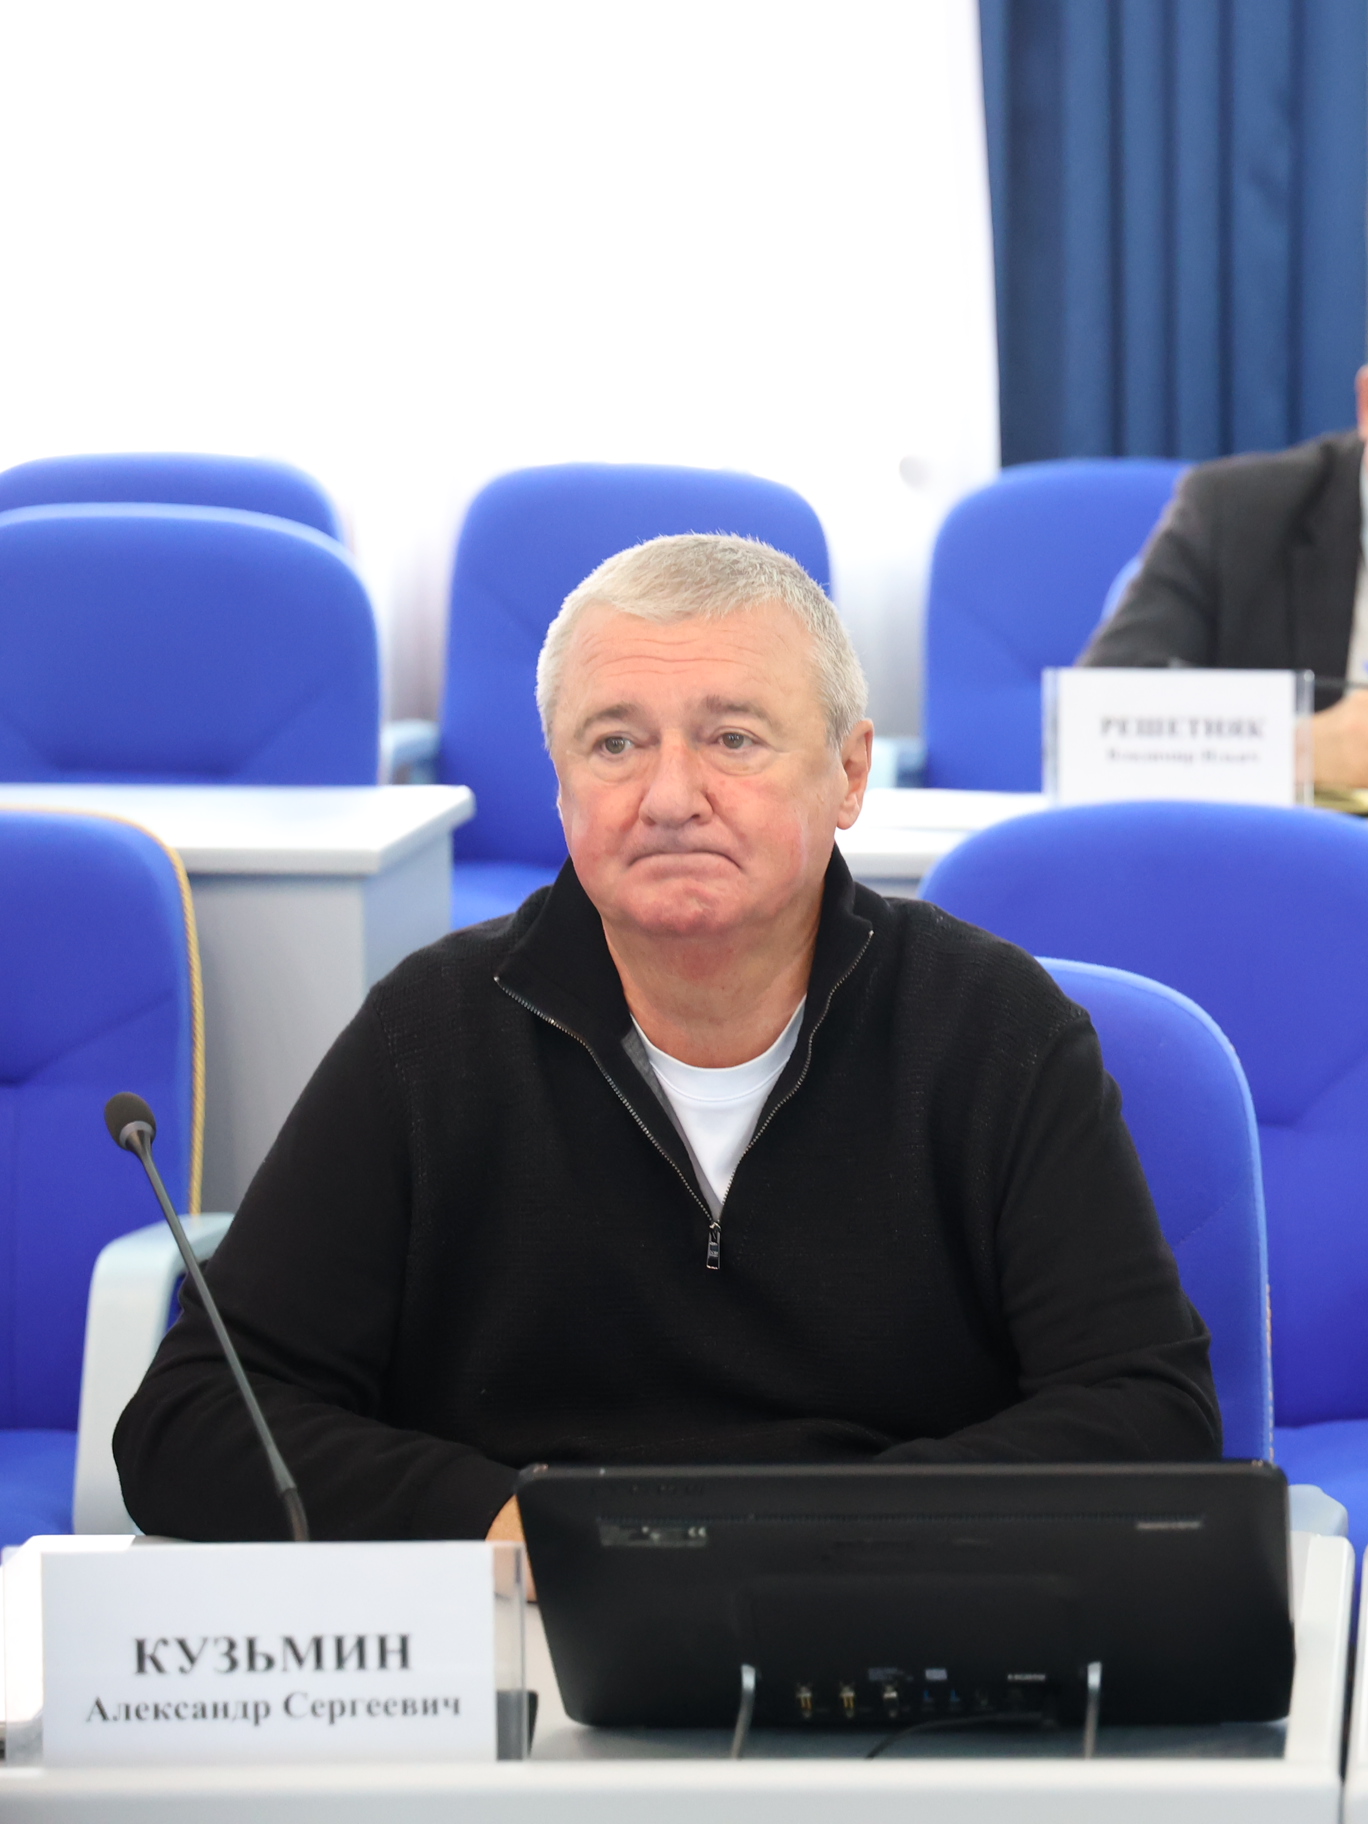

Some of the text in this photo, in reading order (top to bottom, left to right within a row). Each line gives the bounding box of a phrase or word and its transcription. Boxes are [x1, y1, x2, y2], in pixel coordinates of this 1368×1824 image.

[133, 1633, 412, 1676] КУЗЬМИН
[86, 1691, 462, 1728] Александр Сергеевич
